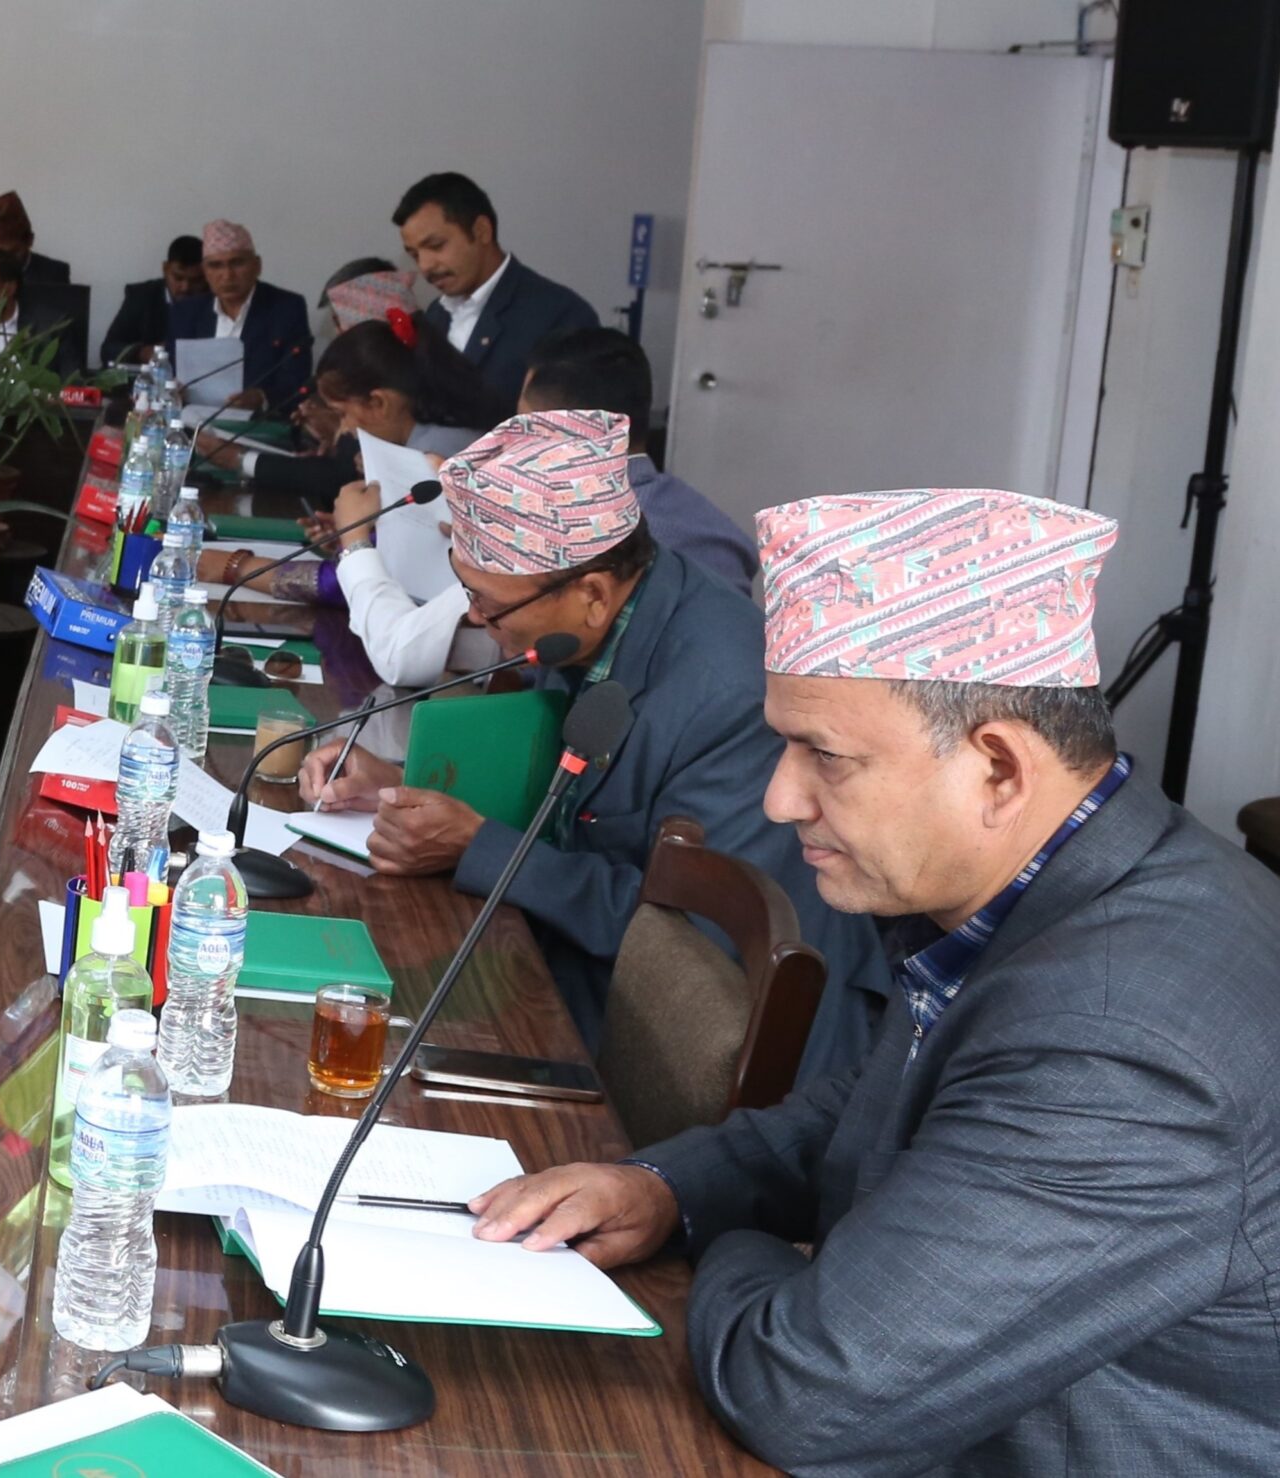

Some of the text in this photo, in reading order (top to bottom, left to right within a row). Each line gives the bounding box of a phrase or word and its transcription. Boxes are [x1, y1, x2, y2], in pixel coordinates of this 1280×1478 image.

[80, 609, 118, 628] PREMIUM
[61, 779, 77, 790] 100
[200, 943, 228, 954] AQUA
[78, 1131, 105, 1152] AQUA
